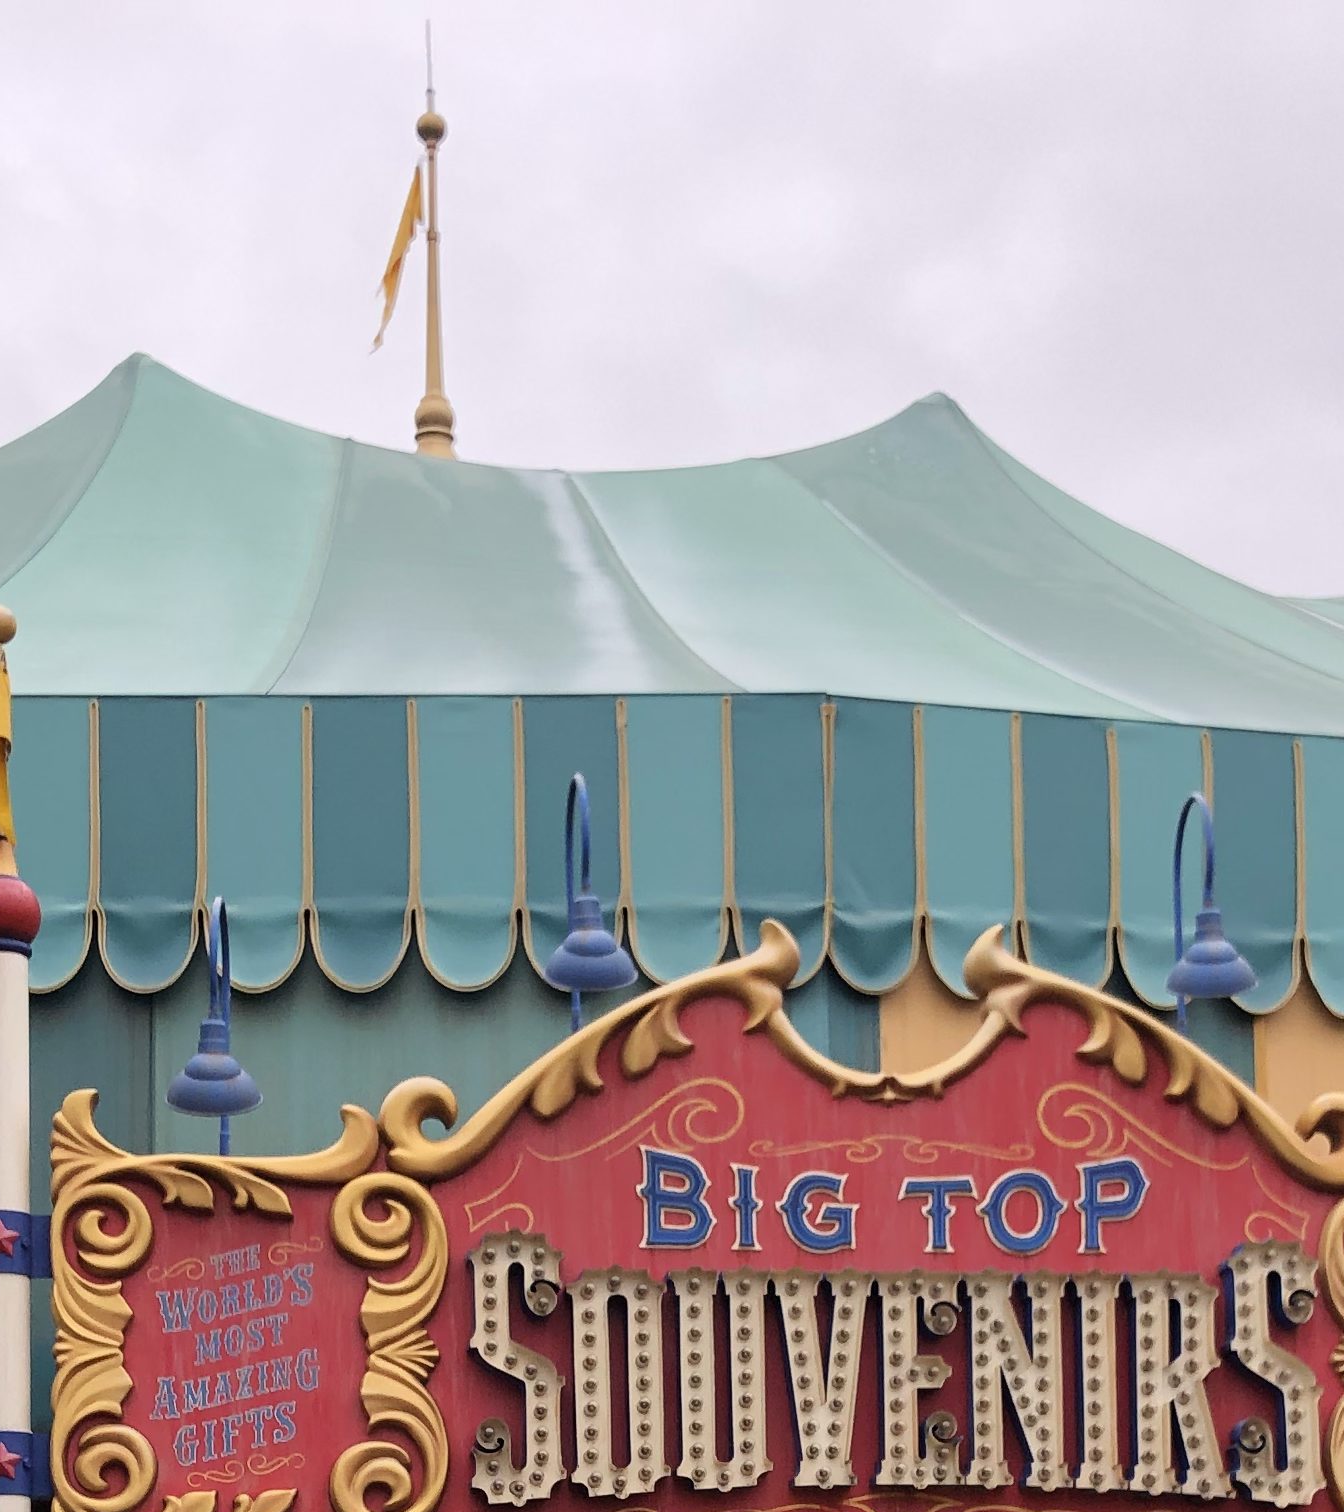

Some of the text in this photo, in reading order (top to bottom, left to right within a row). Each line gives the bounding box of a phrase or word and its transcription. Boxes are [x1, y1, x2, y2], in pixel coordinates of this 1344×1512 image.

[638, 1146, 1150, 1254] BIG TOP
[210, 1244, 260, 1279] THE
[156, 1263, 314, 1333] WORLD'S
[194, 1313, 288, 1366] MOST
[467, 1230, 1327, 1508] SOUVENIRS
[149, 1348, 320, 1420] AMAZING
[173, 1401, 297, 1466] GIFTS
